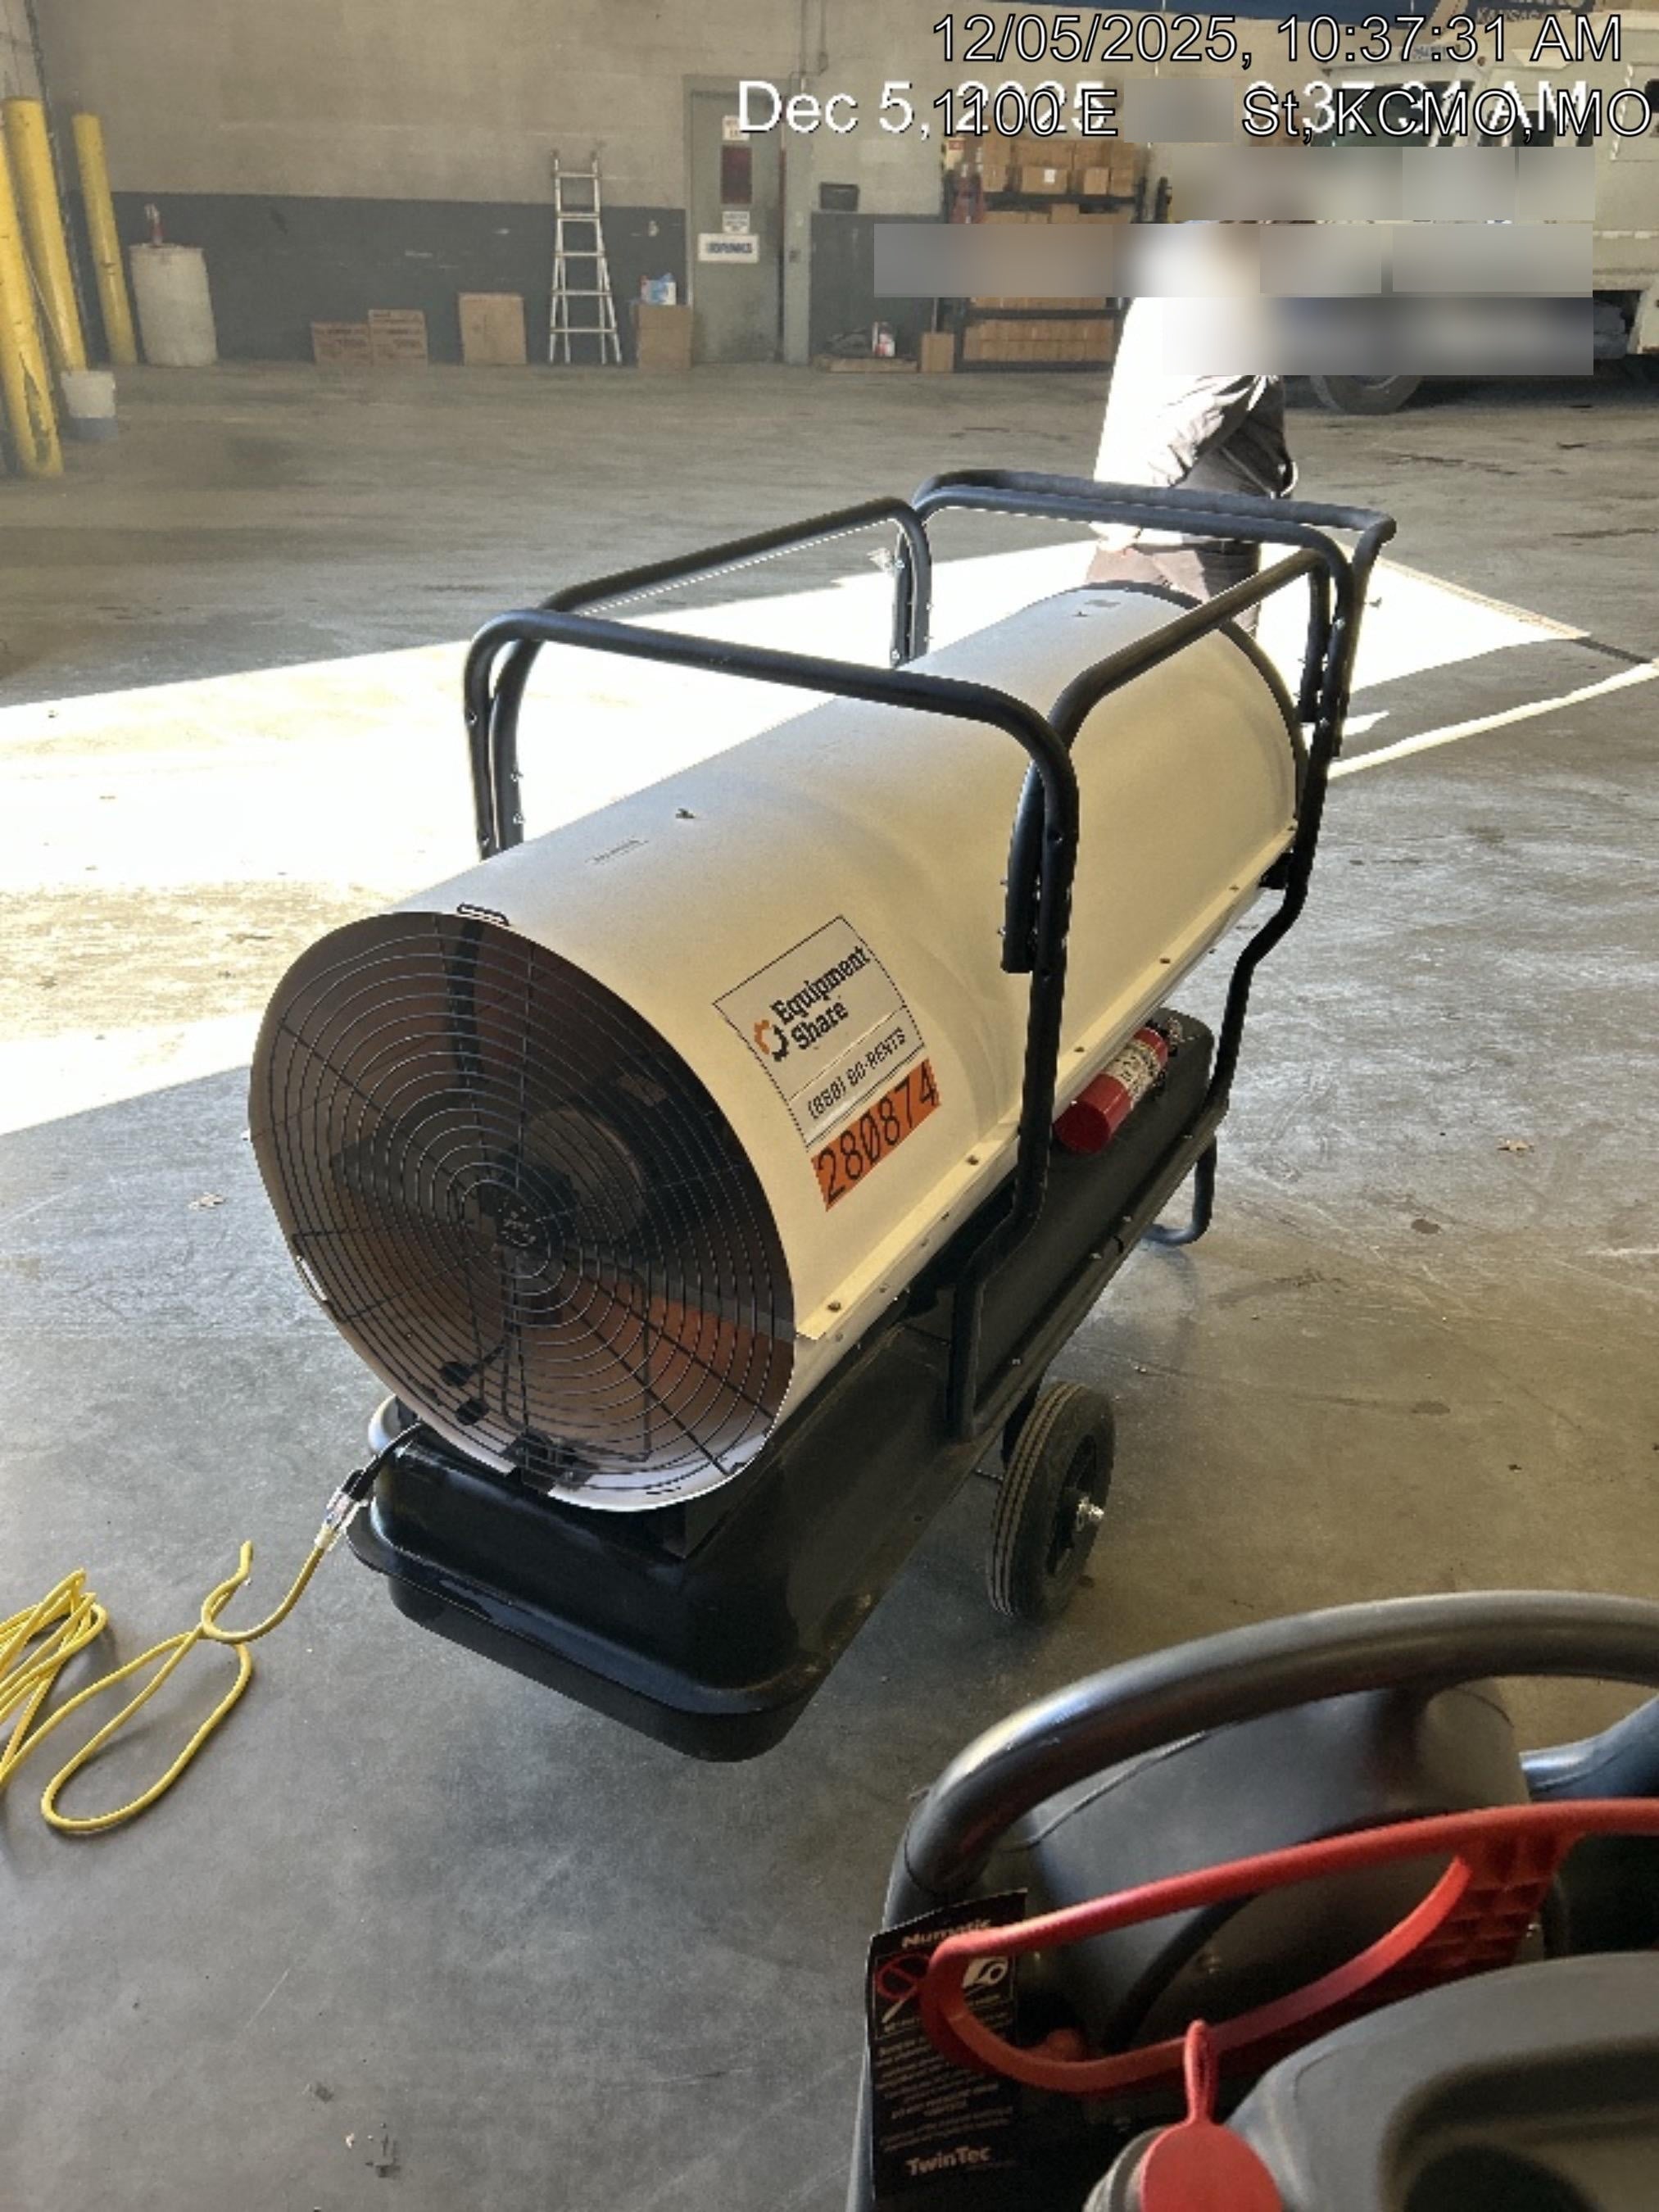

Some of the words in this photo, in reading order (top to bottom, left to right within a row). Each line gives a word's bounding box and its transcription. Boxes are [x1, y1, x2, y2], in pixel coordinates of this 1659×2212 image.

[770, 945, 872, 1025] Equipment
[791, 1000, 849, 1050] Share
[816, 1068, 937, 1206] 280874
[905, 2145, 992, 2177] TwinTec
